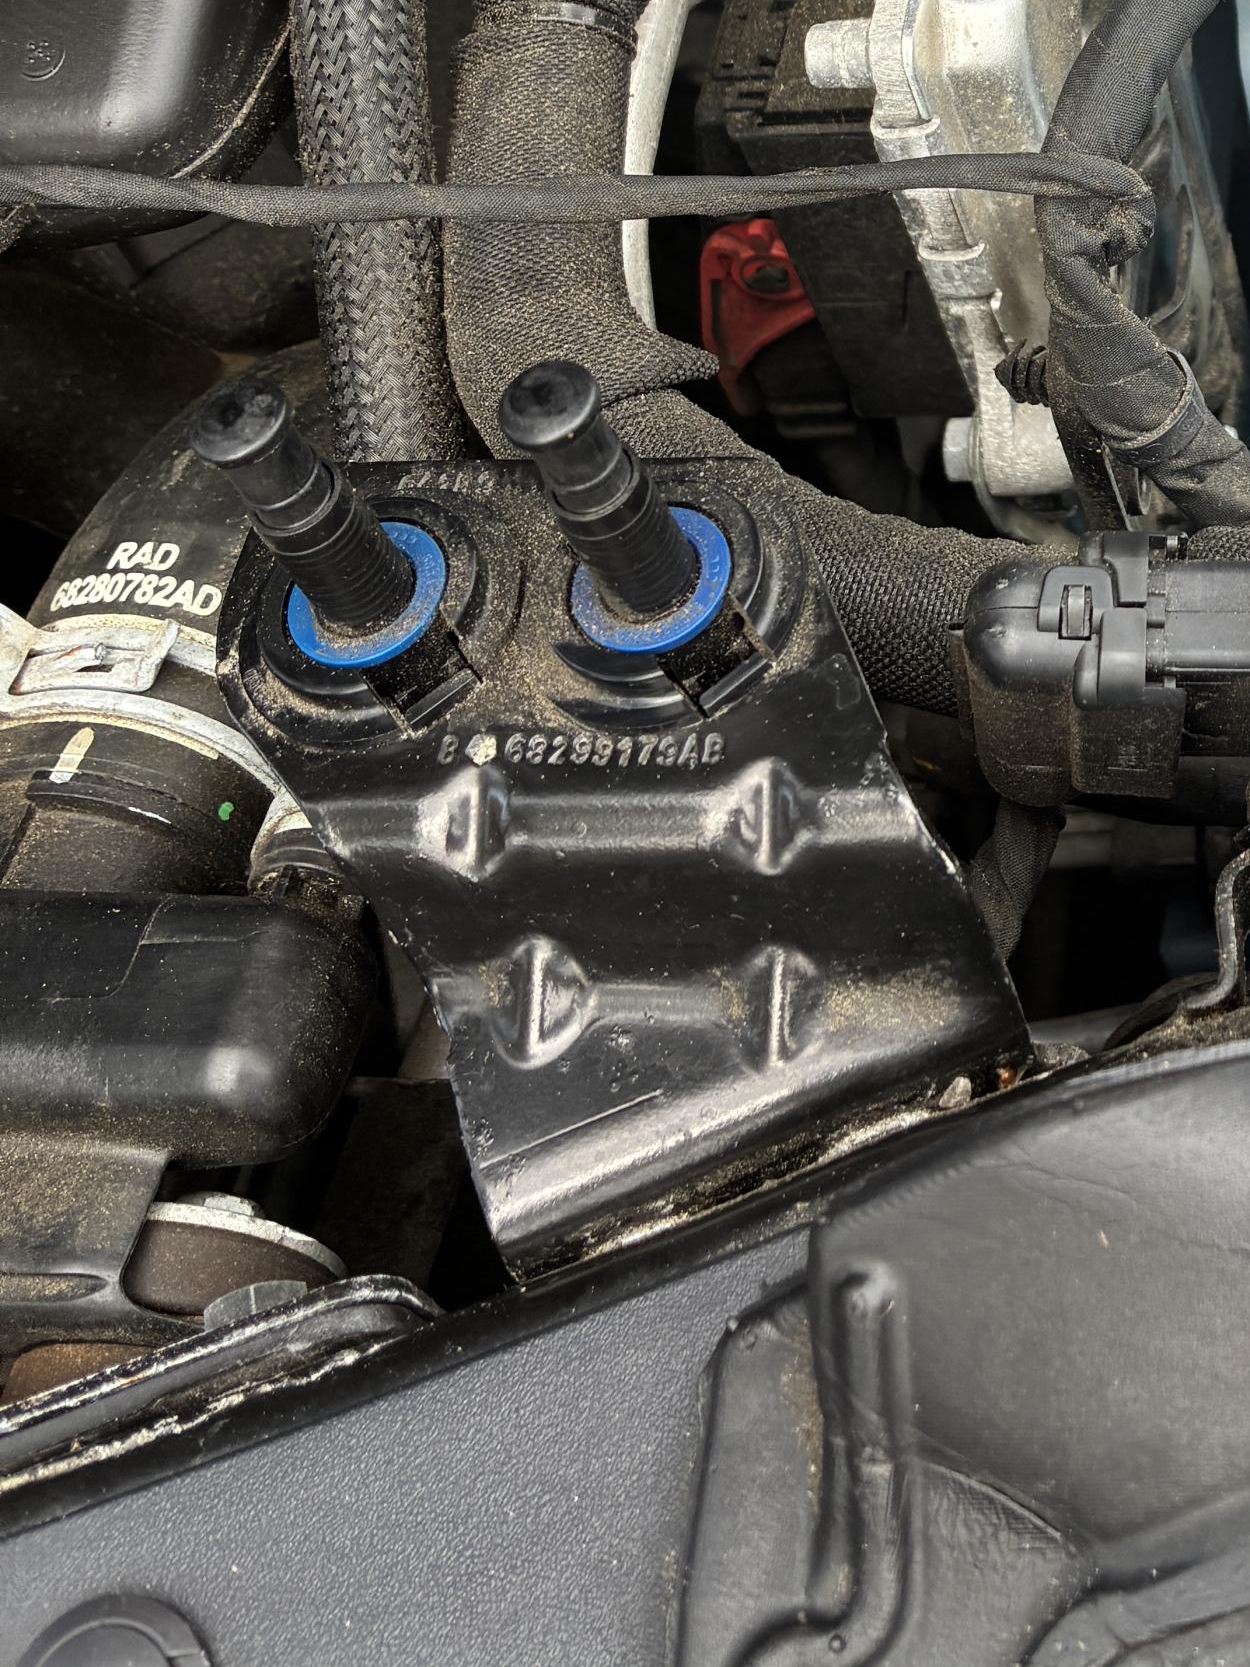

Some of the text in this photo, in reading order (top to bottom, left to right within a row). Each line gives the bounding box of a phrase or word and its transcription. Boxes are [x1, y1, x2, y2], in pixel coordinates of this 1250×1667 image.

[106, 541, 181, 571] RAD
[50, 572, 222, 616] 68280782AD
[504, 732, 725, 770] 68299179AB
